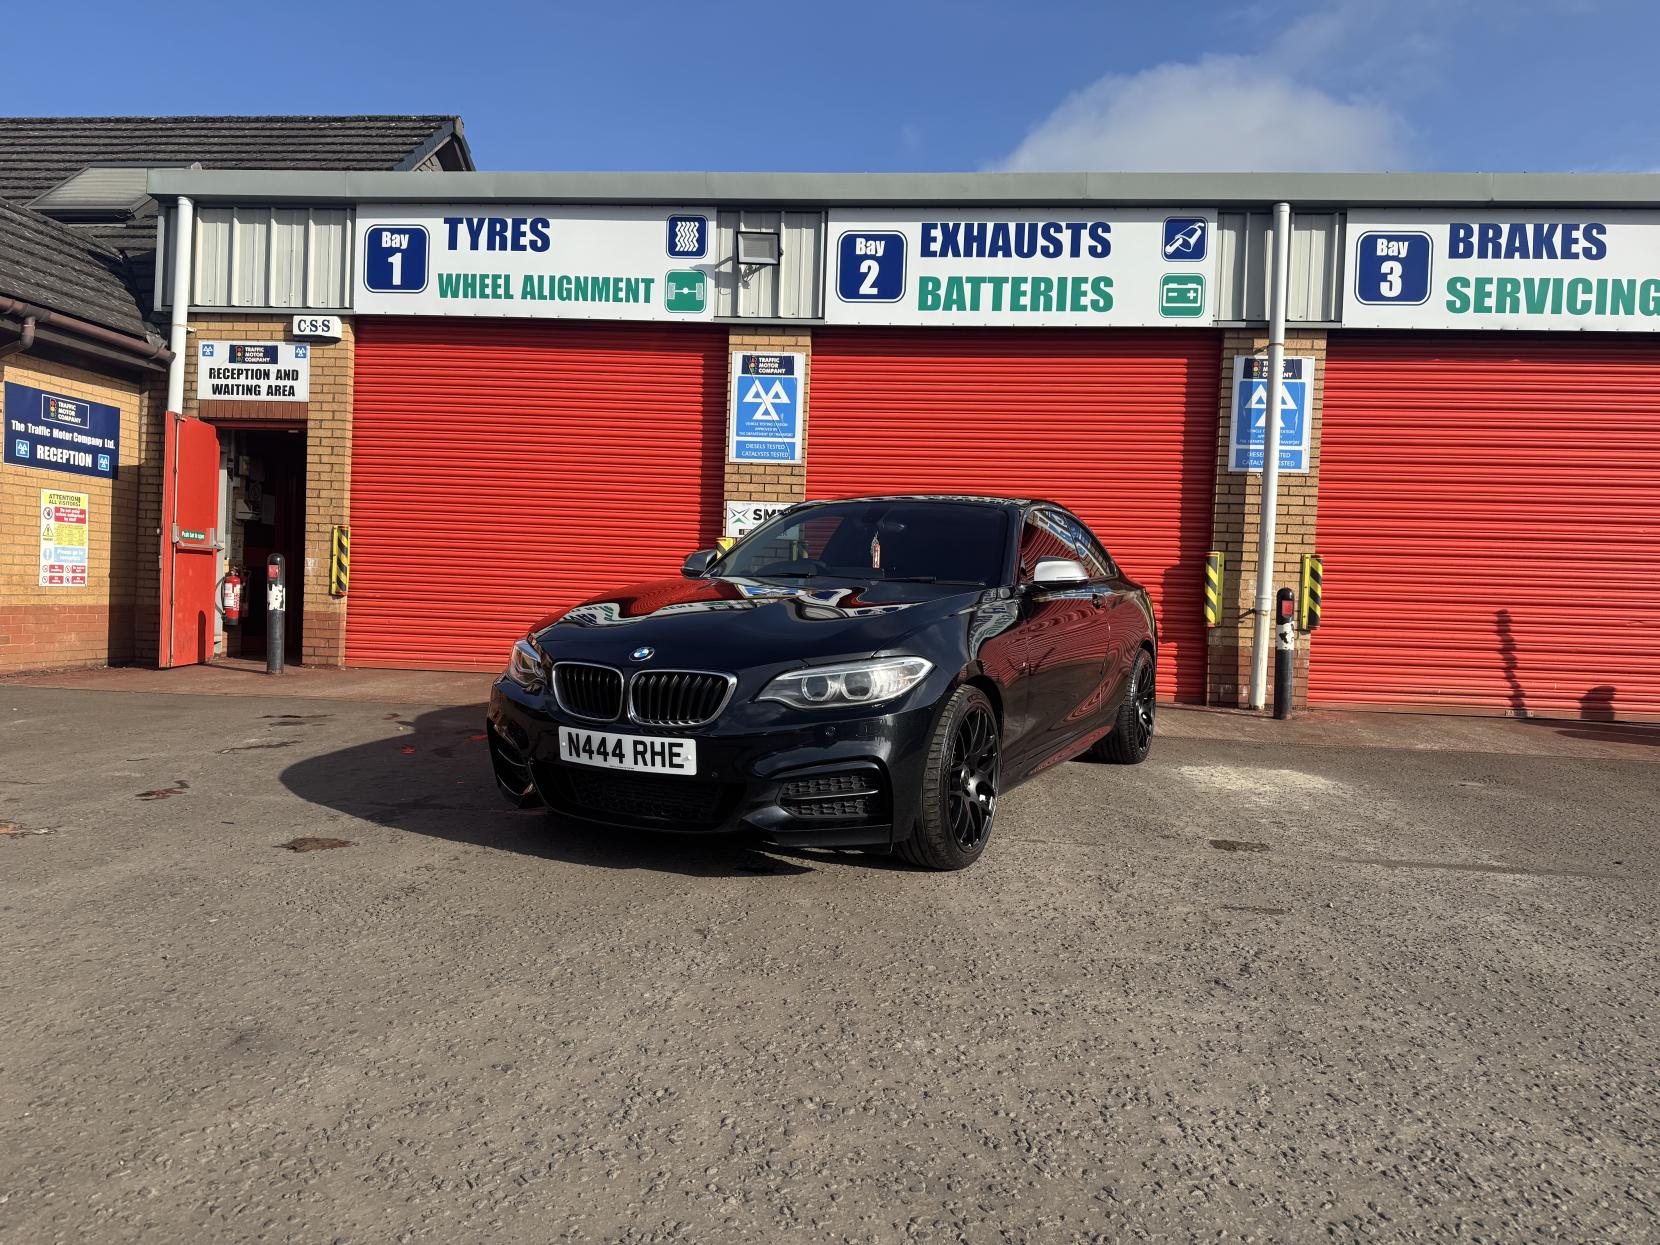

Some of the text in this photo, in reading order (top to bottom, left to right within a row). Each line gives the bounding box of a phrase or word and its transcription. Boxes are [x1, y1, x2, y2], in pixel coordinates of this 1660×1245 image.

[381, 231, 409, 250] Bay
[443, 216, 551, 252] TYRES
[856, 237, 886, 257] Bay
[919, 222, 1112, 258] EXHAUSTS
[1376, 238, 1409, 257] Bay
[1448, 222, 1607, 261] BRAKES
[387, 252, 403, 285] 1
[859, 259, 880, 295] 2
[1379, 260, 1402, 298] 3
[437, 272, 655, 303] WHEEL ALIGNMENT
[918, 276, 1114, 313] BATTERIES
[1445, 276, 1660, 316] SERVICING
[208, 368, 299, 381] RECEPTION AND
[212, 383, 296, 397] WAITING AREA
[58, 401, 76, 410] TRAFFIC
[58, 408, 76, 417] MOTOR
[58, 414, 82, 423] COMPANY
[11, 420, 116, 449] The Traffic Motor Company Ltd.
[36, 444, 93, 467] RECEPTION
[567, 731, 685, 769] N444 RHE
